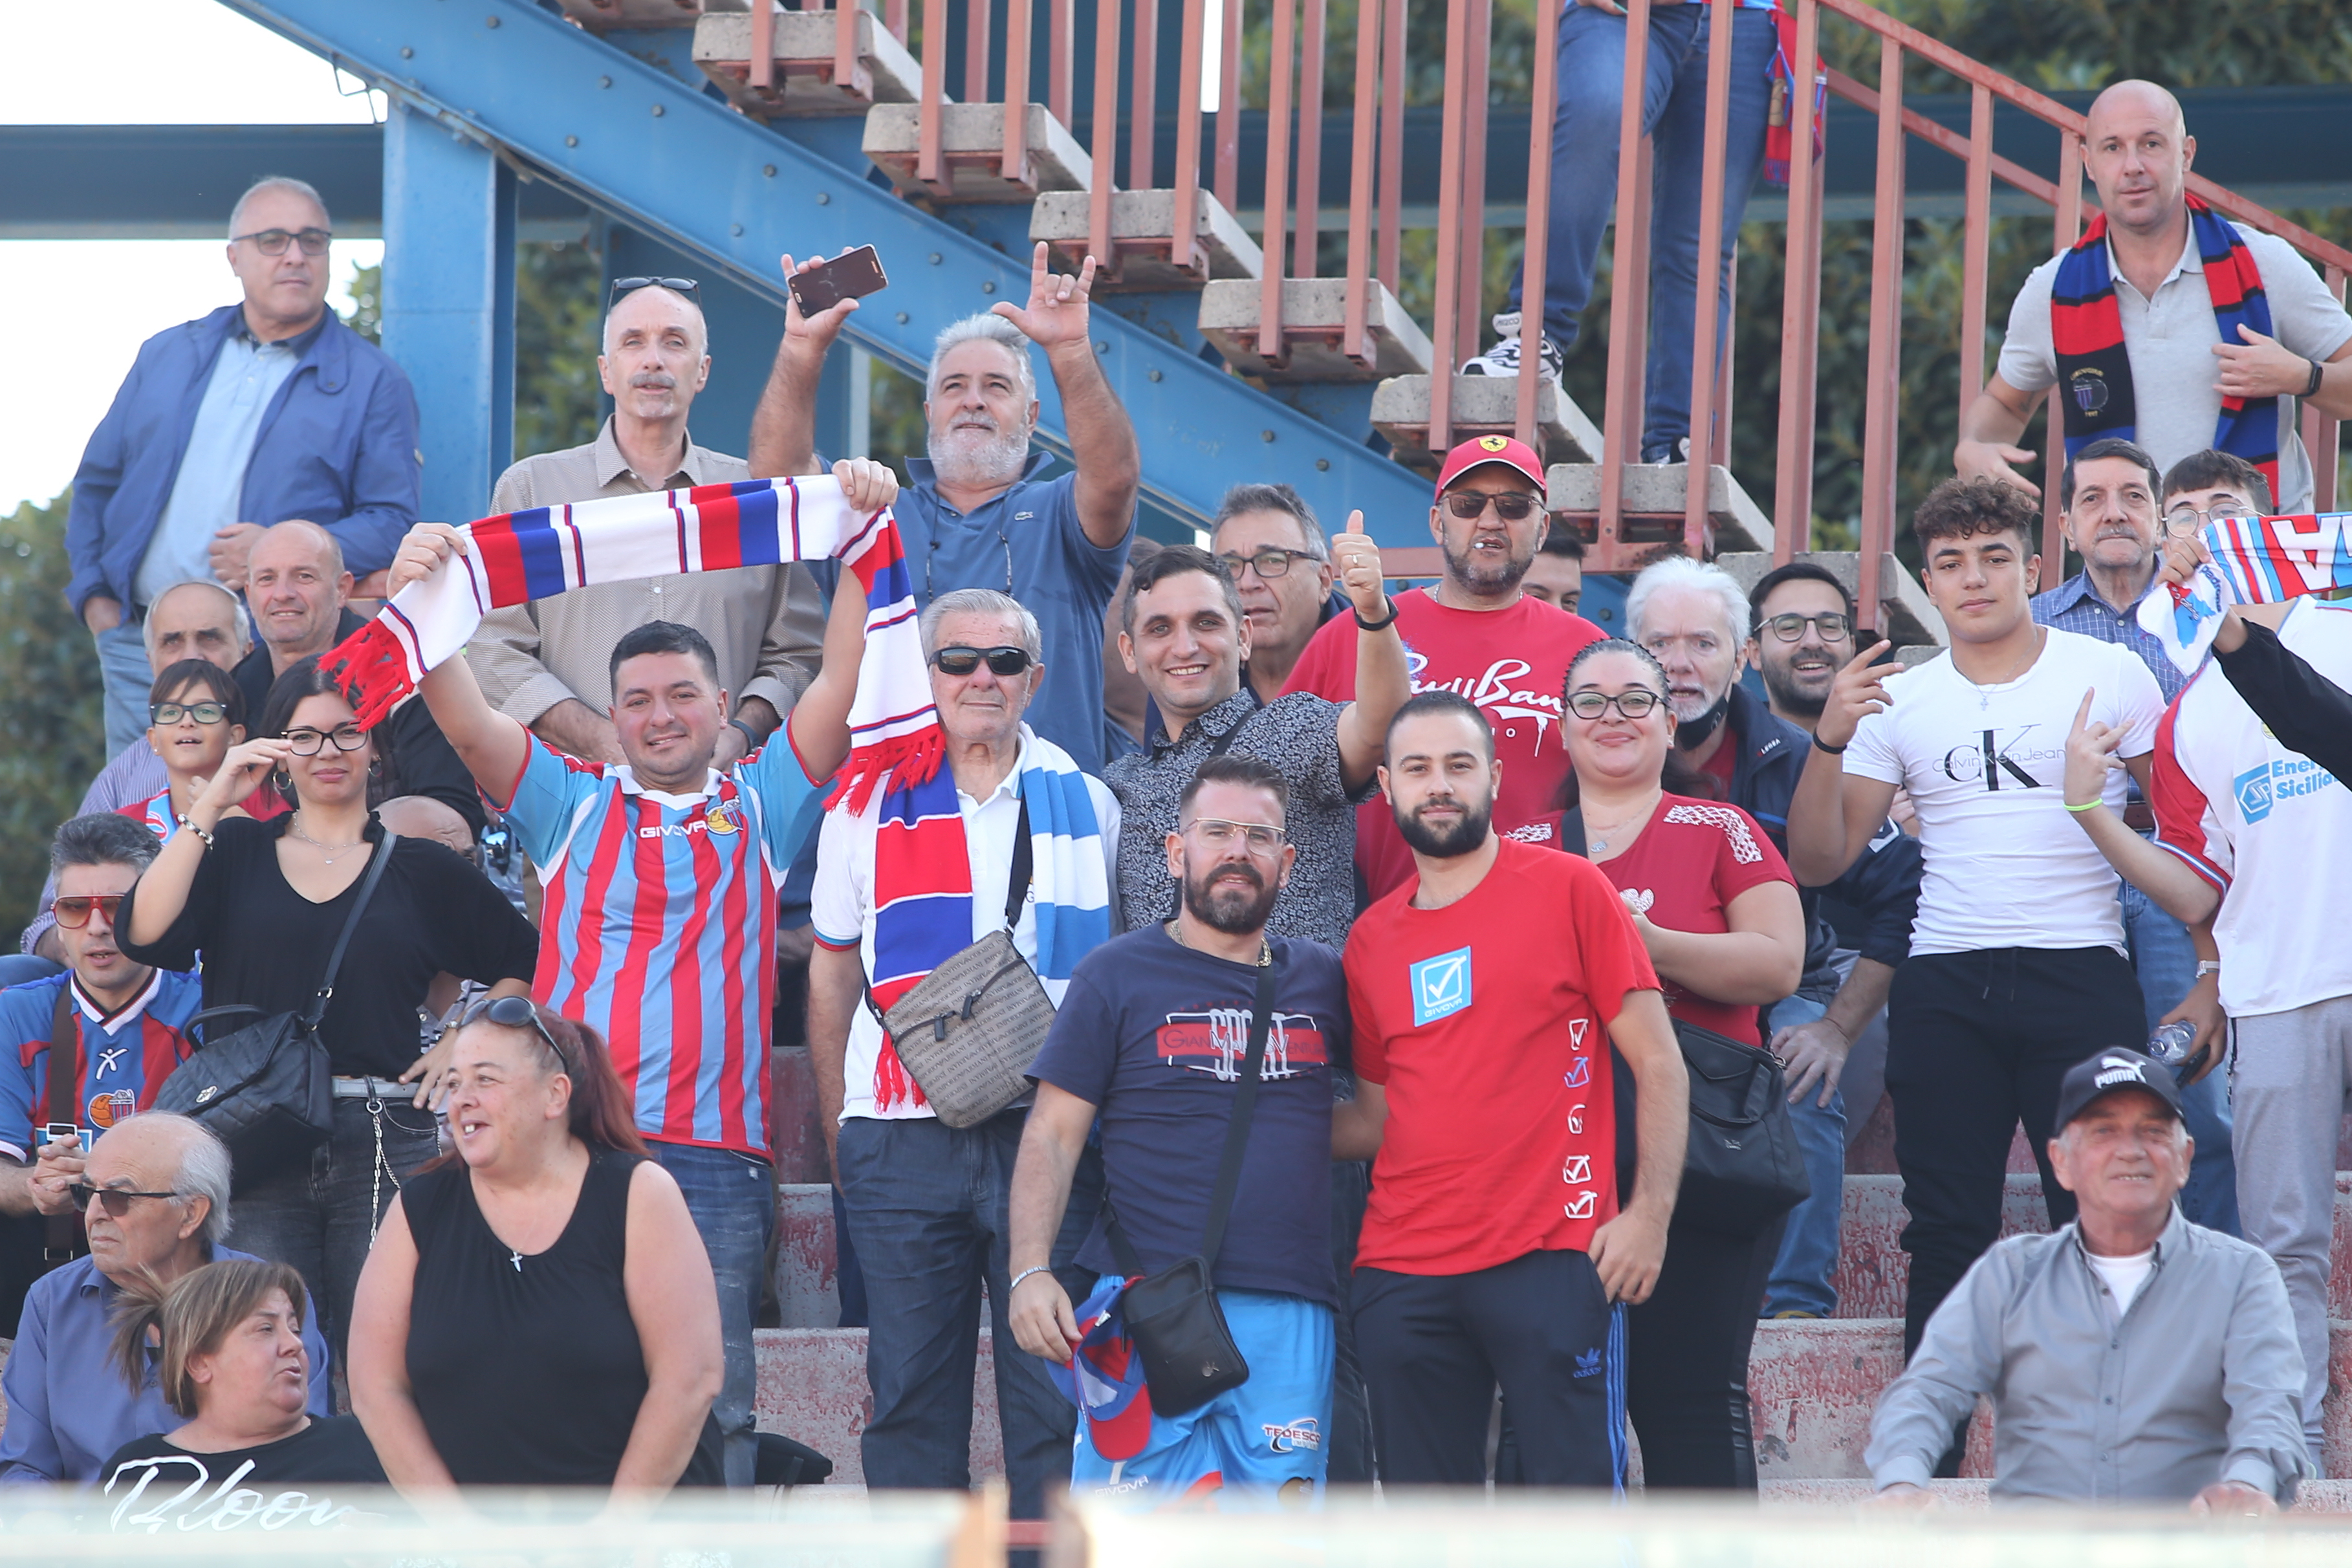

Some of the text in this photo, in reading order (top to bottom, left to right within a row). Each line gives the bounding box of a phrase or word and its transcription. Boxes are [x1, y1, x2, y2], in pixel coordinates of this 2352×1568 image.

[1932, 746, 2067, 772] Calvin Kein Jean
[1944, 723, 2053, 792] CK
[2271, 759, 2325, 778] Ener
[2276, 772, 2340, 800] Sicilia
[1424, 997, 1463, 1018] GIVOVA
[2093, 1068, 2137, 1089] PUMA
[1094, 1475, 1149, 1497] GIVOVA
